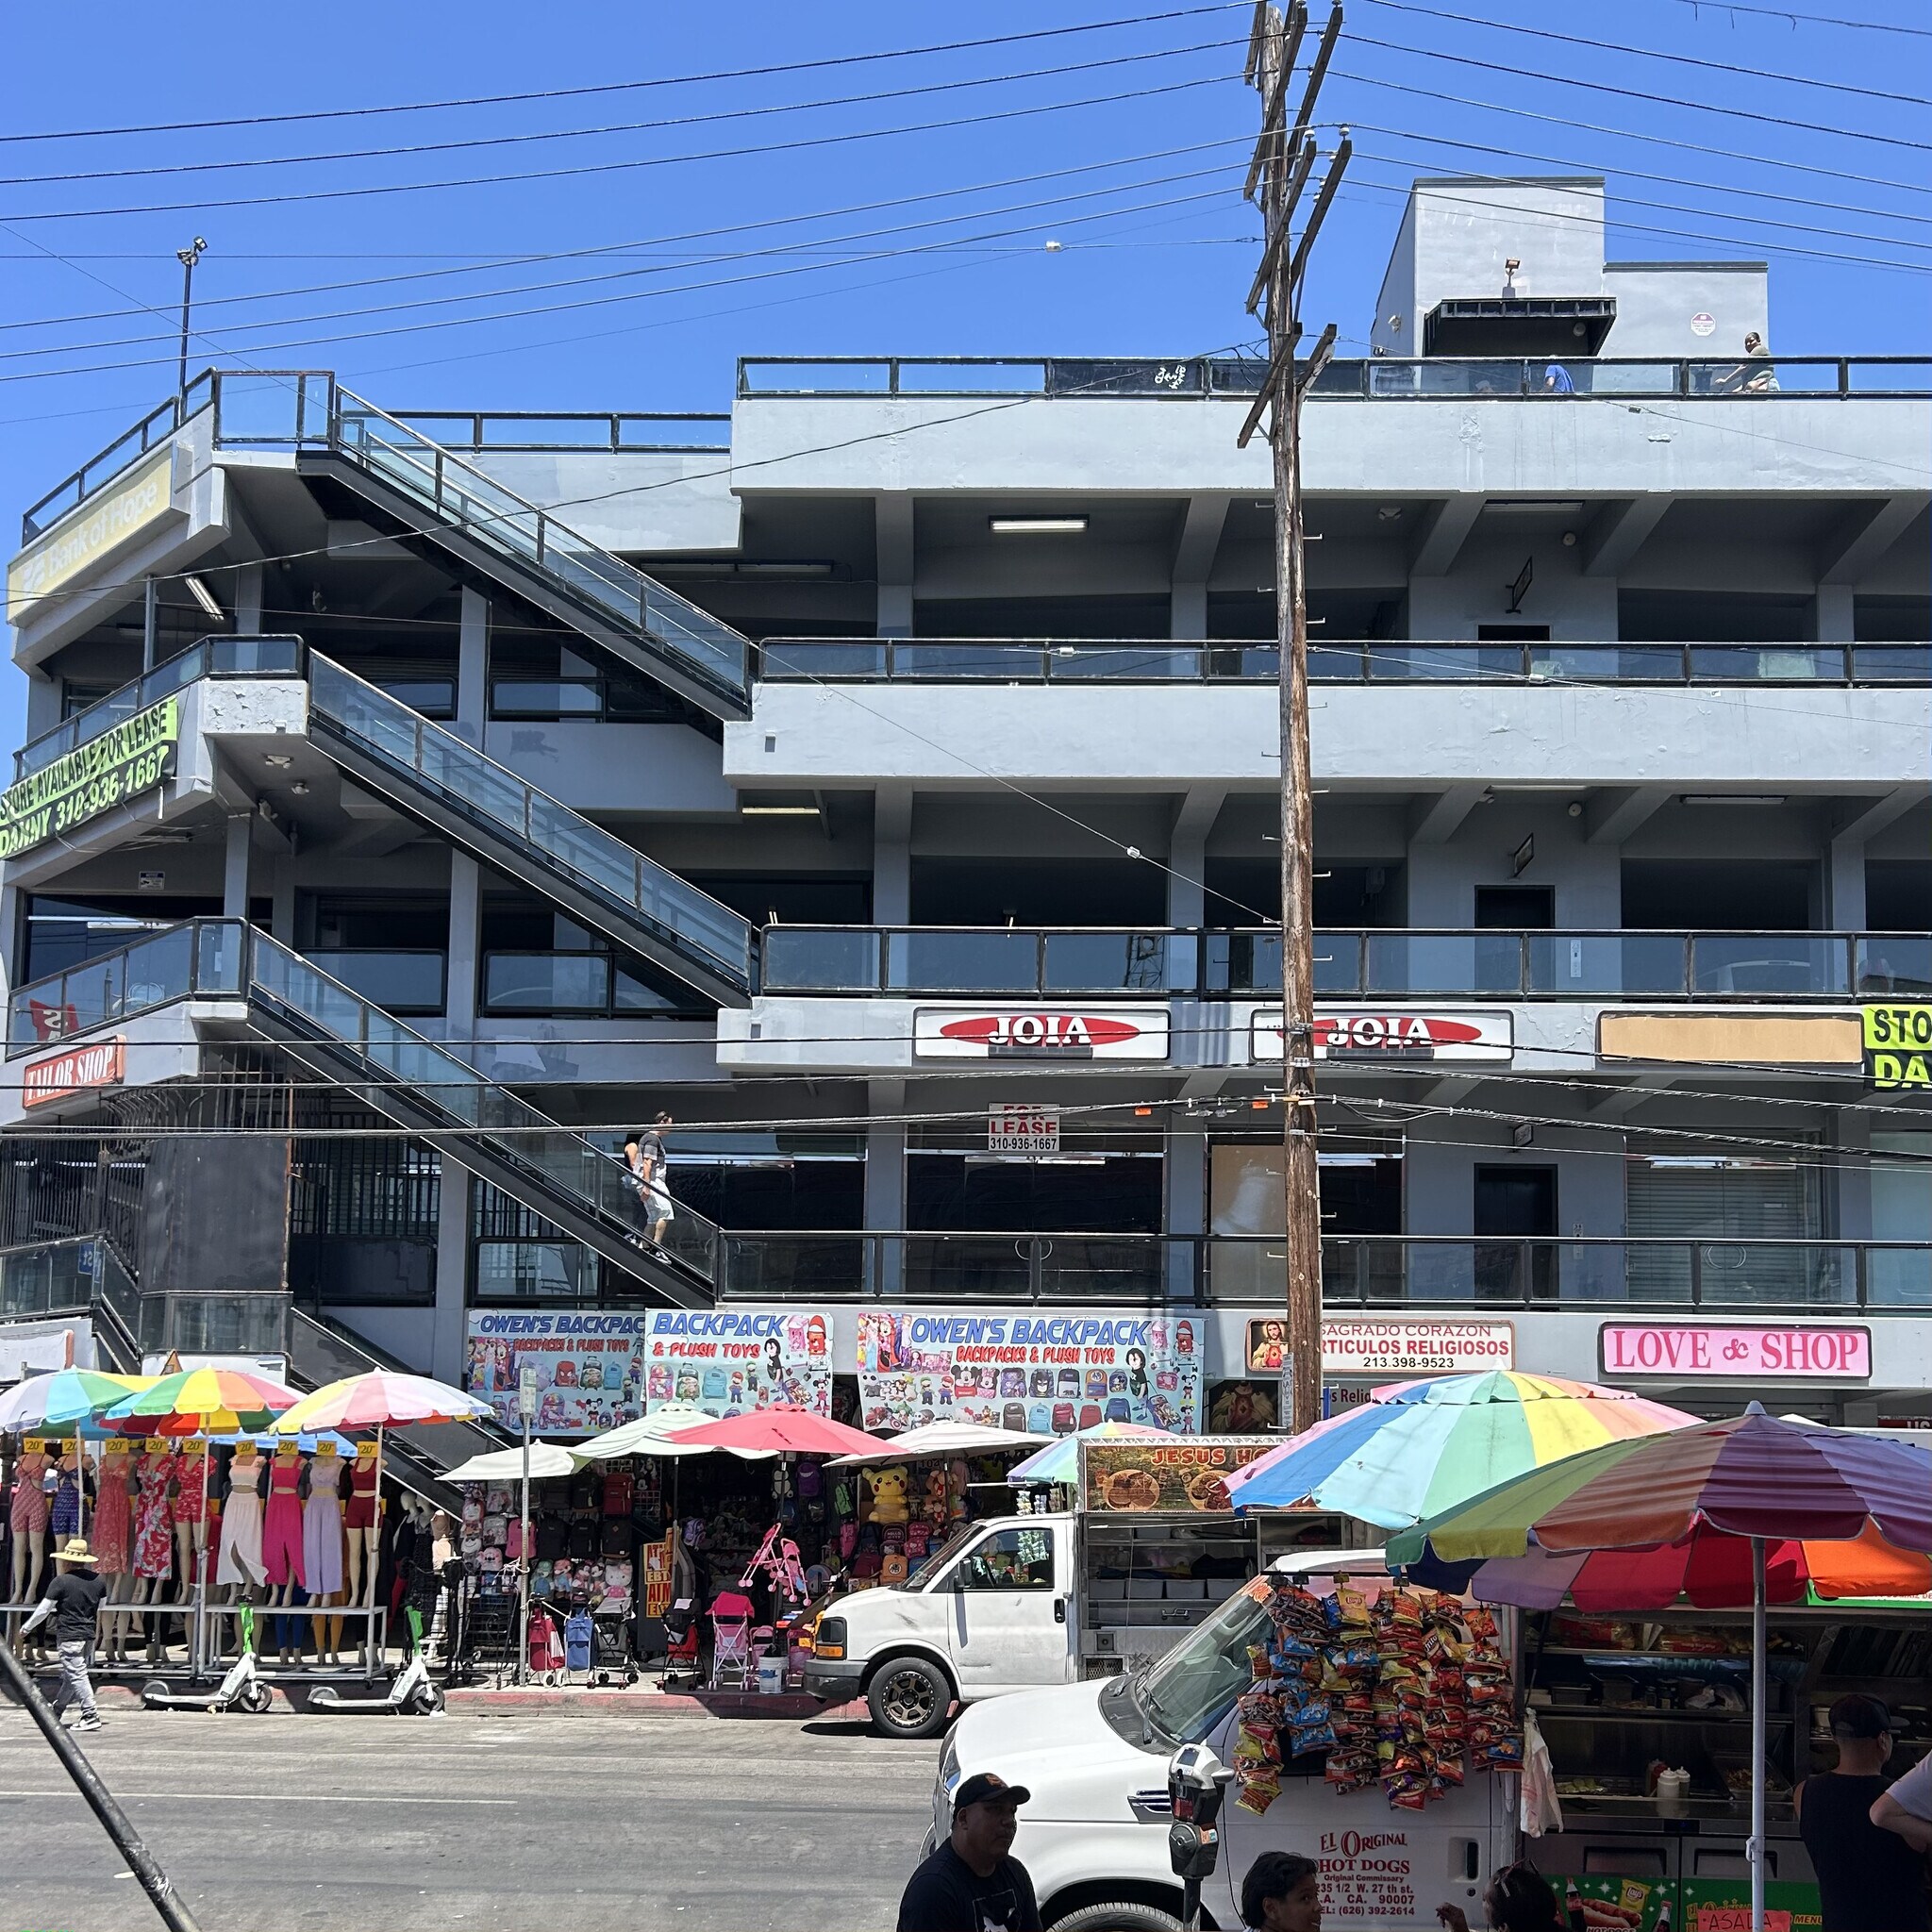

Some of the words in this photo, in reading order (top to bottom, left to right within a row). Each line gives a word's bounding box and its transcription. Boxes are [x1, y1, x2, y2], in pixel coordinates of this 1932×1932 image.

[48, 525, 89, 577] Bank
[90, 509, 107, 545] of
[109, 482, 158, 532] Hope
[38, 743, 97, 802] AVAILABLE
[98, 729, 127, 767] FOR
[127, 702, 168, 752] LEASE
[0, 808, 52, 857] DANNY
[989, 1016, 1091, 1044] JOIA
[1326, 1018, 1433, 1045] JOIA
[27, 1058, 75, 1101] TAILOR
[75, 1046, 112, 1087] SHOP
[1004, 1106, 1045, 1120] FOR
[991, 1121, 1057, 1137] LEASE
[991, 1138, 1057, 1149] 310-936-1667
[480, 1315, 554, 1333] OWEN'S
[556, 1316, 645, 1334] BACKPAC
[653, 1312, 788, 1337] BACKPACK
[911, 1317, 1008, 1343] OWEN'S
[1010, 1319, 1151, 1345] BACKPACK
[1405, 1324, 1491, 1337] CORAZON
[513, 1338, 565, 1353] BACKPACKS
[567, 1338, 574, 1352] &
[576, 1339, 605, 1353] PLUSH
[607, 1339, 630, 1353] TOYS
[653, 1341, 665, 1357] &
[670, 1341, 718, 1357] PLUSH
[723, 1342, 761, 1358] TOYS
[1323, 1340, 1401, 1355] RTICULOS
[1407, 1340, 1509, 1356] RELIGIOSOS
[1613, 1330, 1711, 1369] LOVE
[1723, 1338, 1749, 1360] &
[1761, 1333, 1858, 1371] SHOP
[956, 1345, 1026, 1364] BACKPACKS
[1030, 1347, 1039, 1363] &
[1042, 1347, 1082, 1364] PLUSH
[1085, 1347, 1115, 1364] TOYS
[1363, 1357, 1455, 1369] 213.398-9523
[1151, 1447, 1226, 1465] JESUS
[647, 1571, 669, 1582] EBT
[1319, 1858, 1357, 1874] HOT
[1360, 1859, 1410, 1874] DOGS
[1324, 1874, 1354, 1883] Original
[1356, 1874, 1405, 1884] Commissary
[1336, 1883, 1351, 1893] 1/2
[1357, 1884, 1369, 1893] W.
[1372, 1884, 1384, 1893] 27
[1387, 1884, 1397, 1893] th
[1347, 1894, 1367, 1904] CA.
[1378, 1895, 1415, 1905] 90007
[1321, 1907, 1335, 1915] EL:
[1339, 1906, 1365, 1916] (626)
[1368, 1906, 1415, 1916] 392-2614
